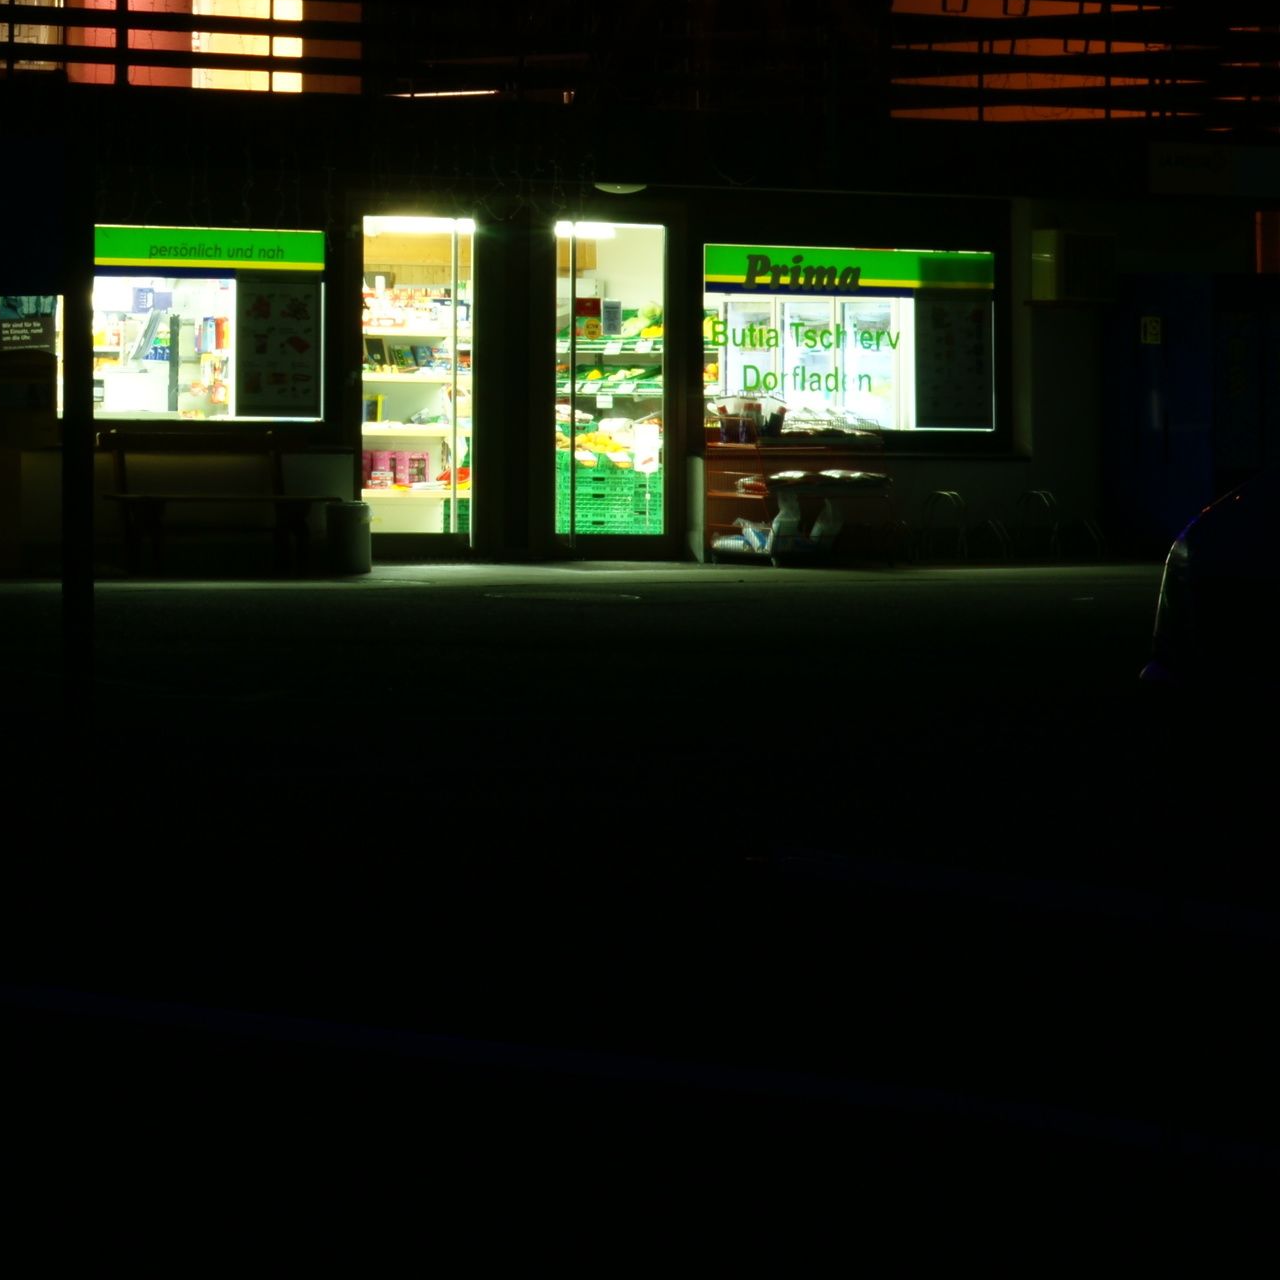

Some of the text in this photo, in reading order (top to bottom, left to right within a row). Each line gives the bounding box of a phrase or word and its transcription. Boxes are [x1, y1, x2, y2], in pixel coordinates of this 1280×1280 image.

[148, 242, 285, 259] persönlich und nah
[741, 254, 862, 291] Prima
[790, 322, 900, 351] Tschierv
